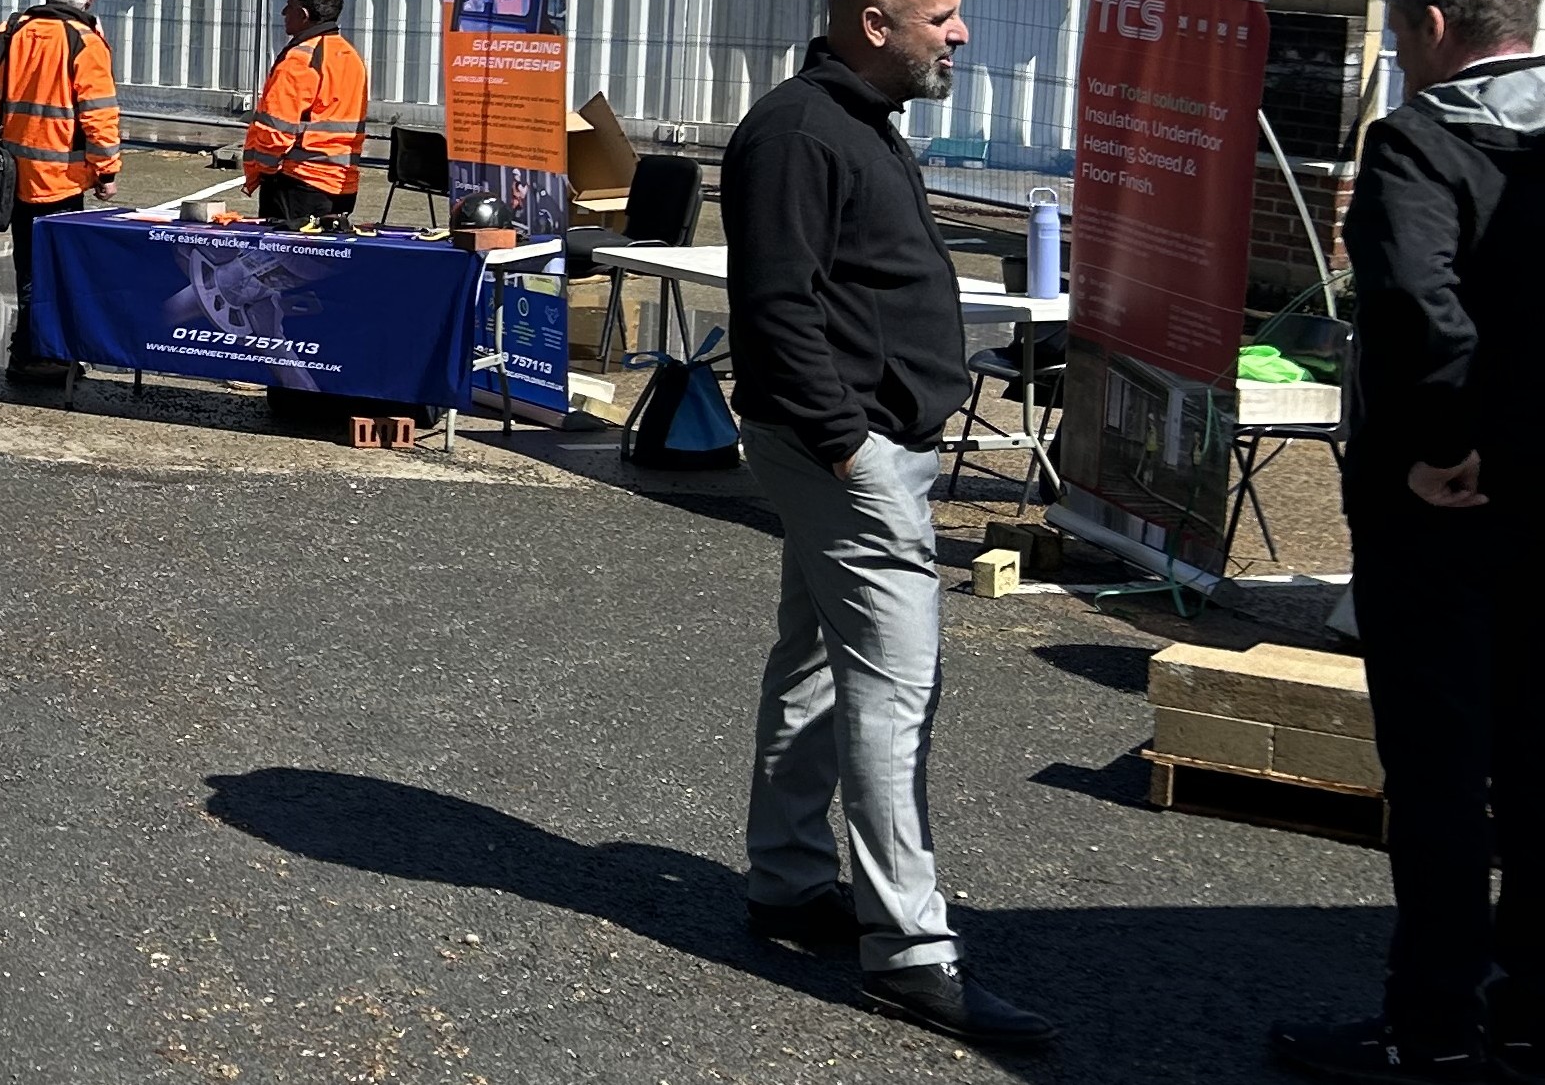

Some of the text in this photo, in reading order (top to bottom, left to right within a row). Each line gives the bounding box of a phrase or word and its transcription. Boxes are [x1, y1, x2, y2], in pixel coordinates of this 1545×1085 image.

[472, 39, 562, 55] SCAFFOLDING
[452, 55, 562, 73] APPRENTICESHIP
[1087, 77, 1228, 121] Your Total solution for
[1084, 106, 1223, 151] Insulation, Underfloor
[1138, 146, 1182, 173] Screed
[1184, 158, 1196, 176] &
[1082, 162, 1155, 196] Floor Finish.
[148, 229, 176, 243] Safer,
[177, 234, 210, 247] easier,
[258, 242, 291, 253] better
[293, 247, 352, 259] connected!
[172, 327, 320, 355] 01279 757113
[511, 354, 553, 374] 757113
